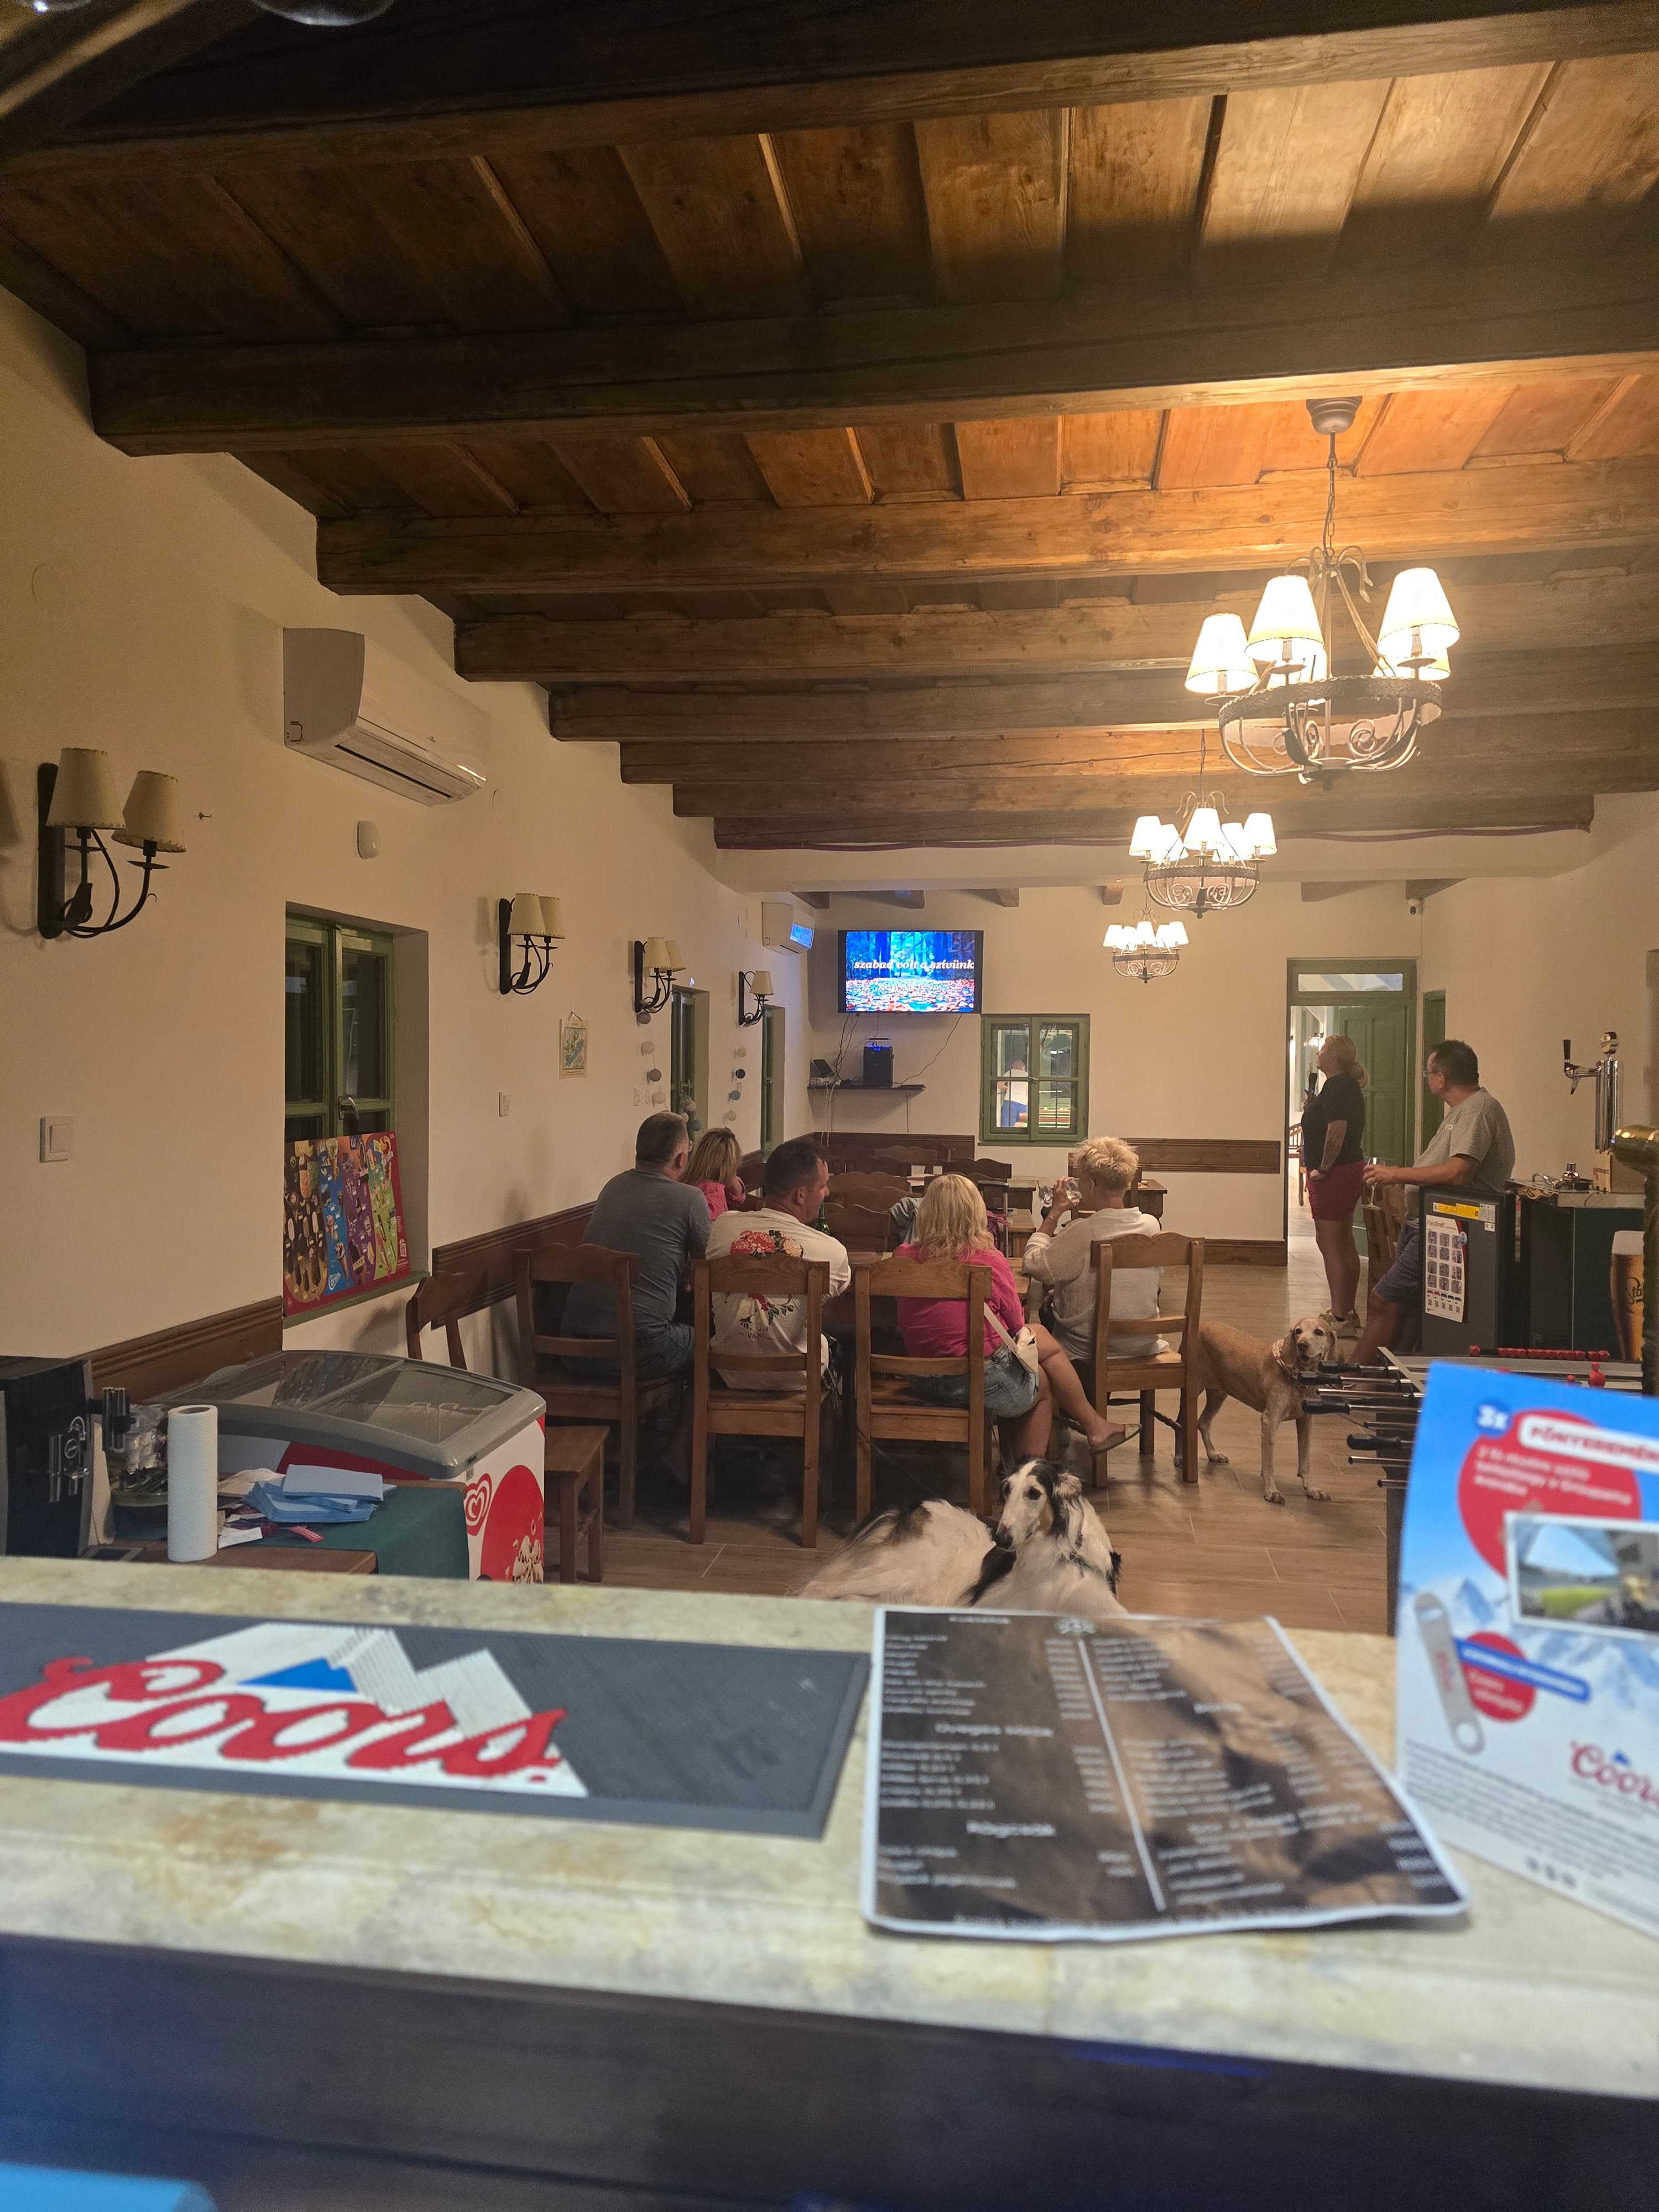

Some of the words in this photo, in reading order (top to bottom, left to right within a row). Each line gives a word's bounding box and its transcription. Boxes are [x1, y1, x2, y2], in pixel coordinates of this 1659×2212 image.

[854, 959, 894, 969] szabad
[895, 959, 917, 969] volt
[0, 1657, 567, 1783] Coors
